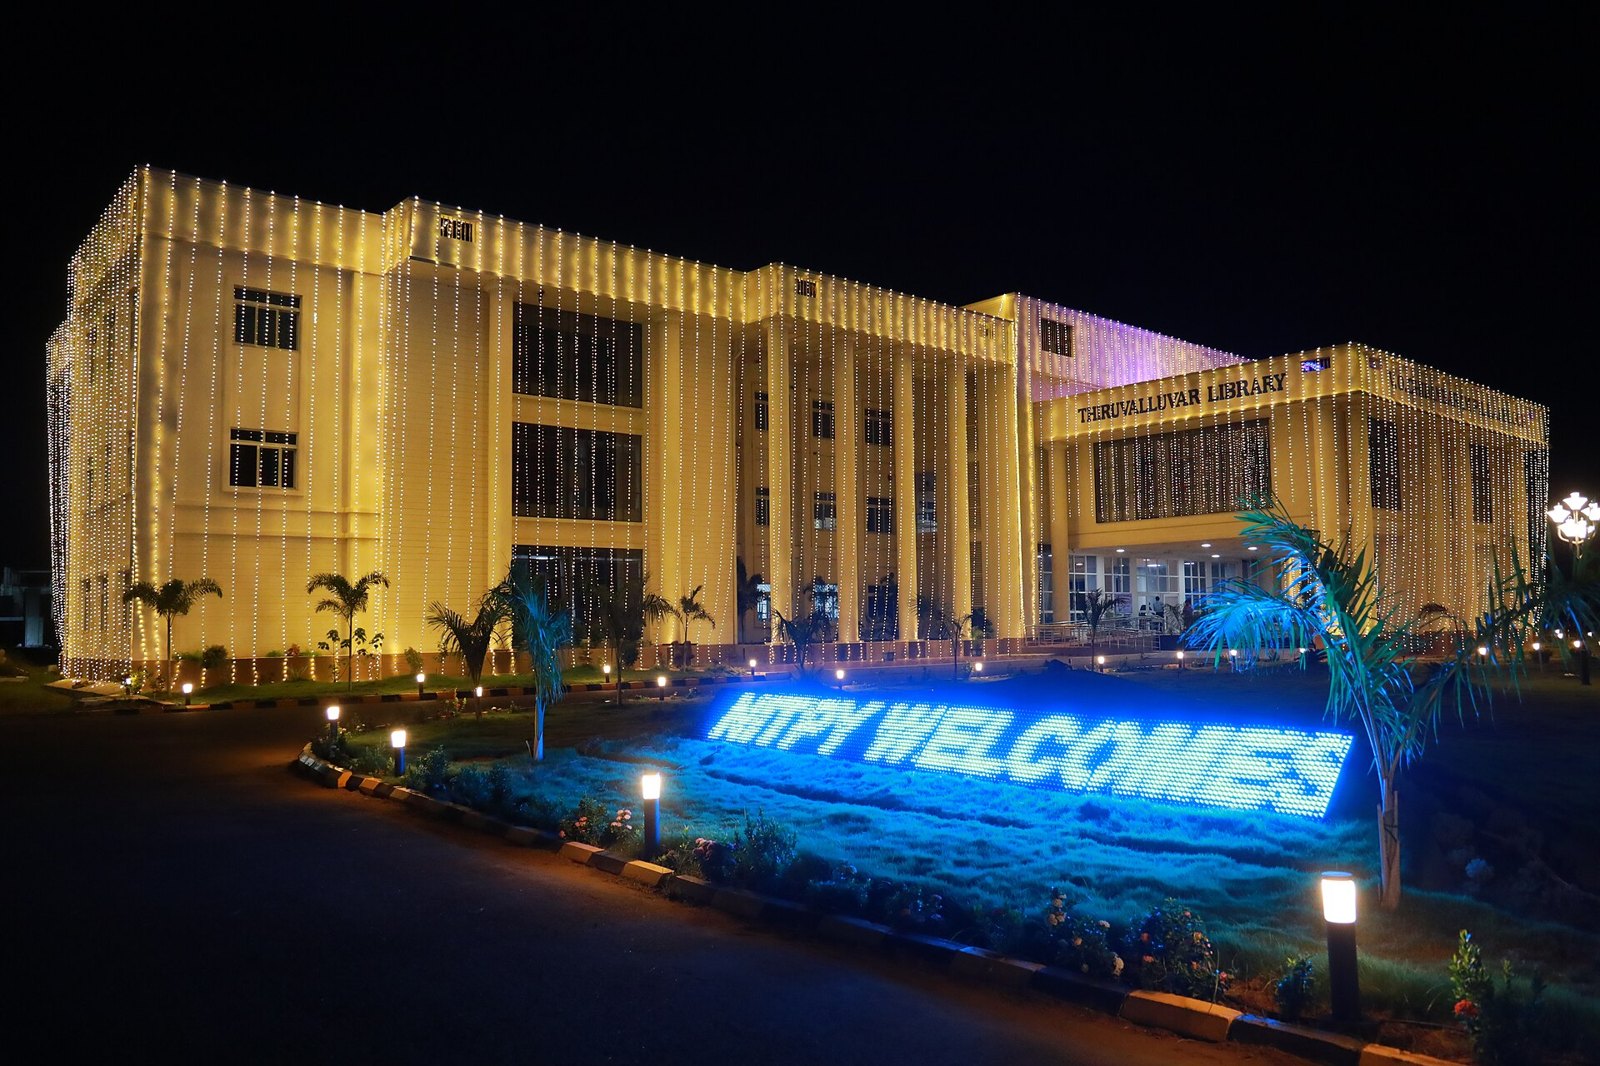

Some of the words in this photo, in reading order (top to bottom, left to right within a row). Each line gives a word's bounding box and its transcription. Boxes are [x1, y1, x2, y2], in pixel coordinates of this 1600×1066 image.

[1078, 389, 1200, 423] THIRUVALLUVAR
[1207, 373, 1286, 402] LIBRARY
[863, 702, 1354, 818] WELCOMES
